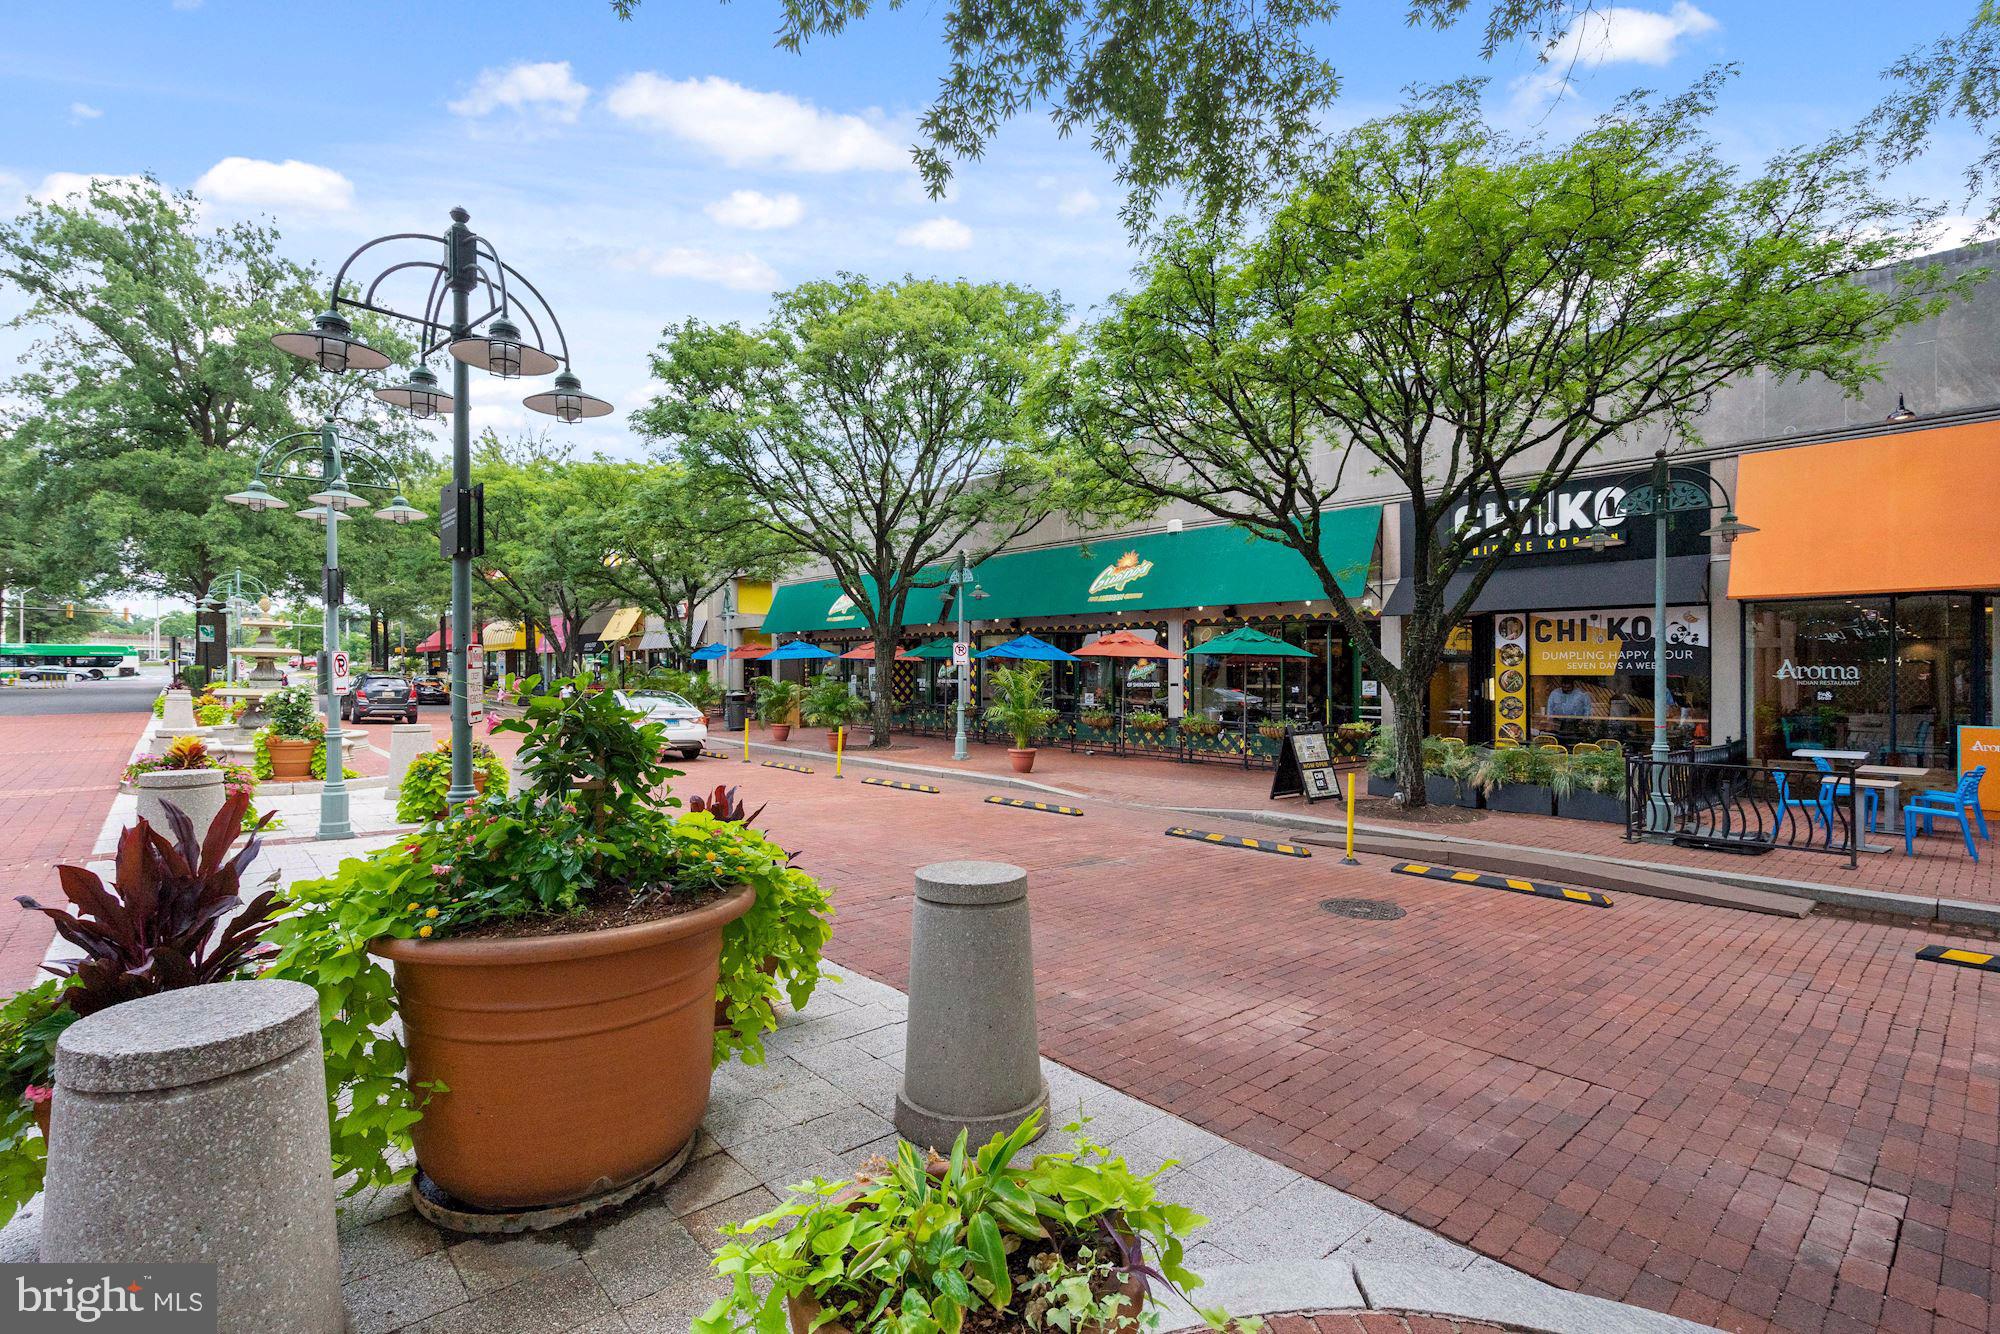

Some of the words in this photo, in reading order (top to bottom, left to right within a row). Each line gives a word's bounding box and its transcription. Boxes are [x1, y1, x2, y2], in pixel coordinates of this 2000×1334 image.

[1542, 651, 1604, 660] DUMPLING
[1609, 650, 1649, 660] HAPPY
[1654, 650, 1693, 660] OUR
[1773, 658, 1860, 680] Aroma
